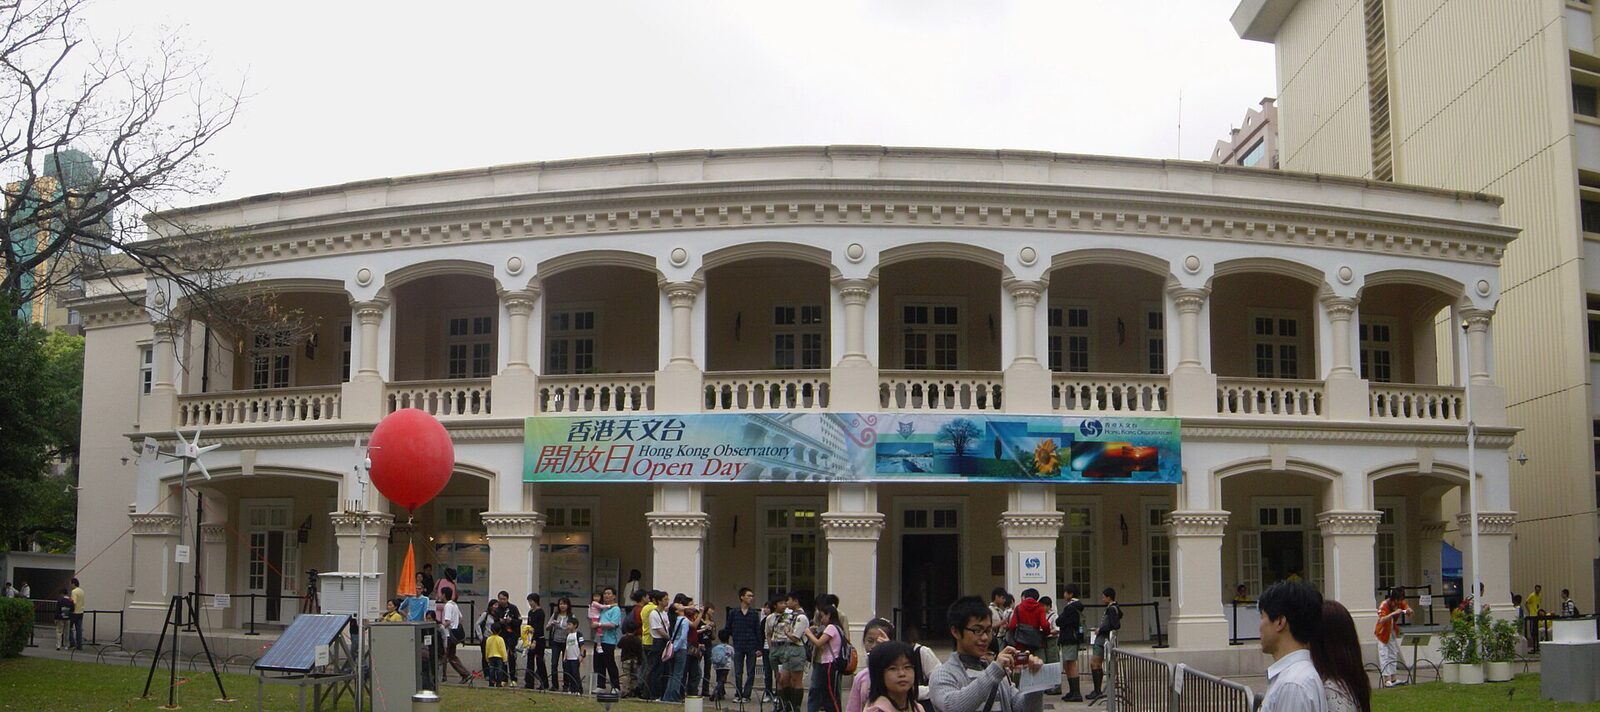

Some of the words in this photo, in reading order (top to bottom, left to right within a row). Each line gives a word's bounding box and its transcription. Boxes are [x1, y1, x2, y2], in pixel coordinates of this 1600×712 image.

[567, 418, 686, 442] 香港天文台
[534, 444, 634, 474] 開放日
[638, 444, 672, 459] Hong
[676, 444, 710, 459] Kong
[713, 444, 793, 460] Observatory
[632, 458, 694, 481] Open
[701, 458, 748, 481] Day
